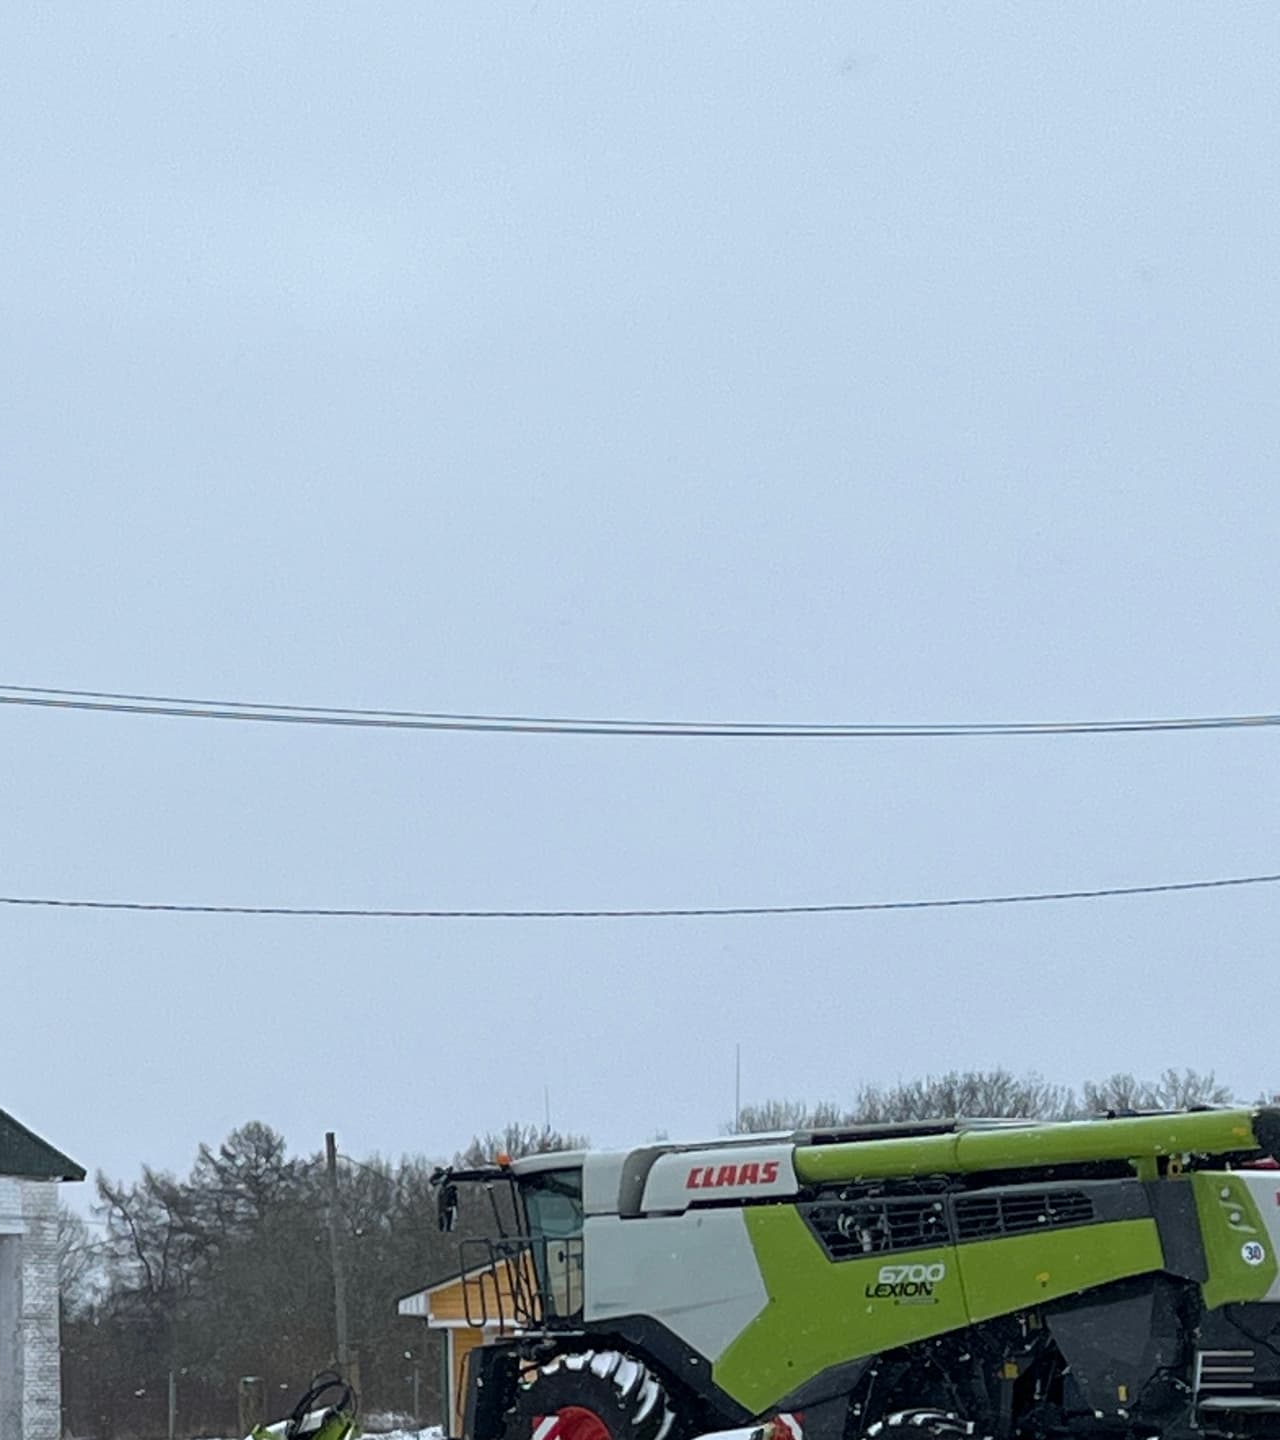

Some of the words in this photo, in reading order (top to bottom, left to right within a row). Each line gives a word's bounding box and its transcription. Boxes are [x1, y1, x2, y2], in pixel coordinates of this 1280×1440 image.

[686, 1161, 780, 1189] CLAAS
[878, 1263, 946, 1284] 6700
[865, 1281, 934, 1298] LEXION
